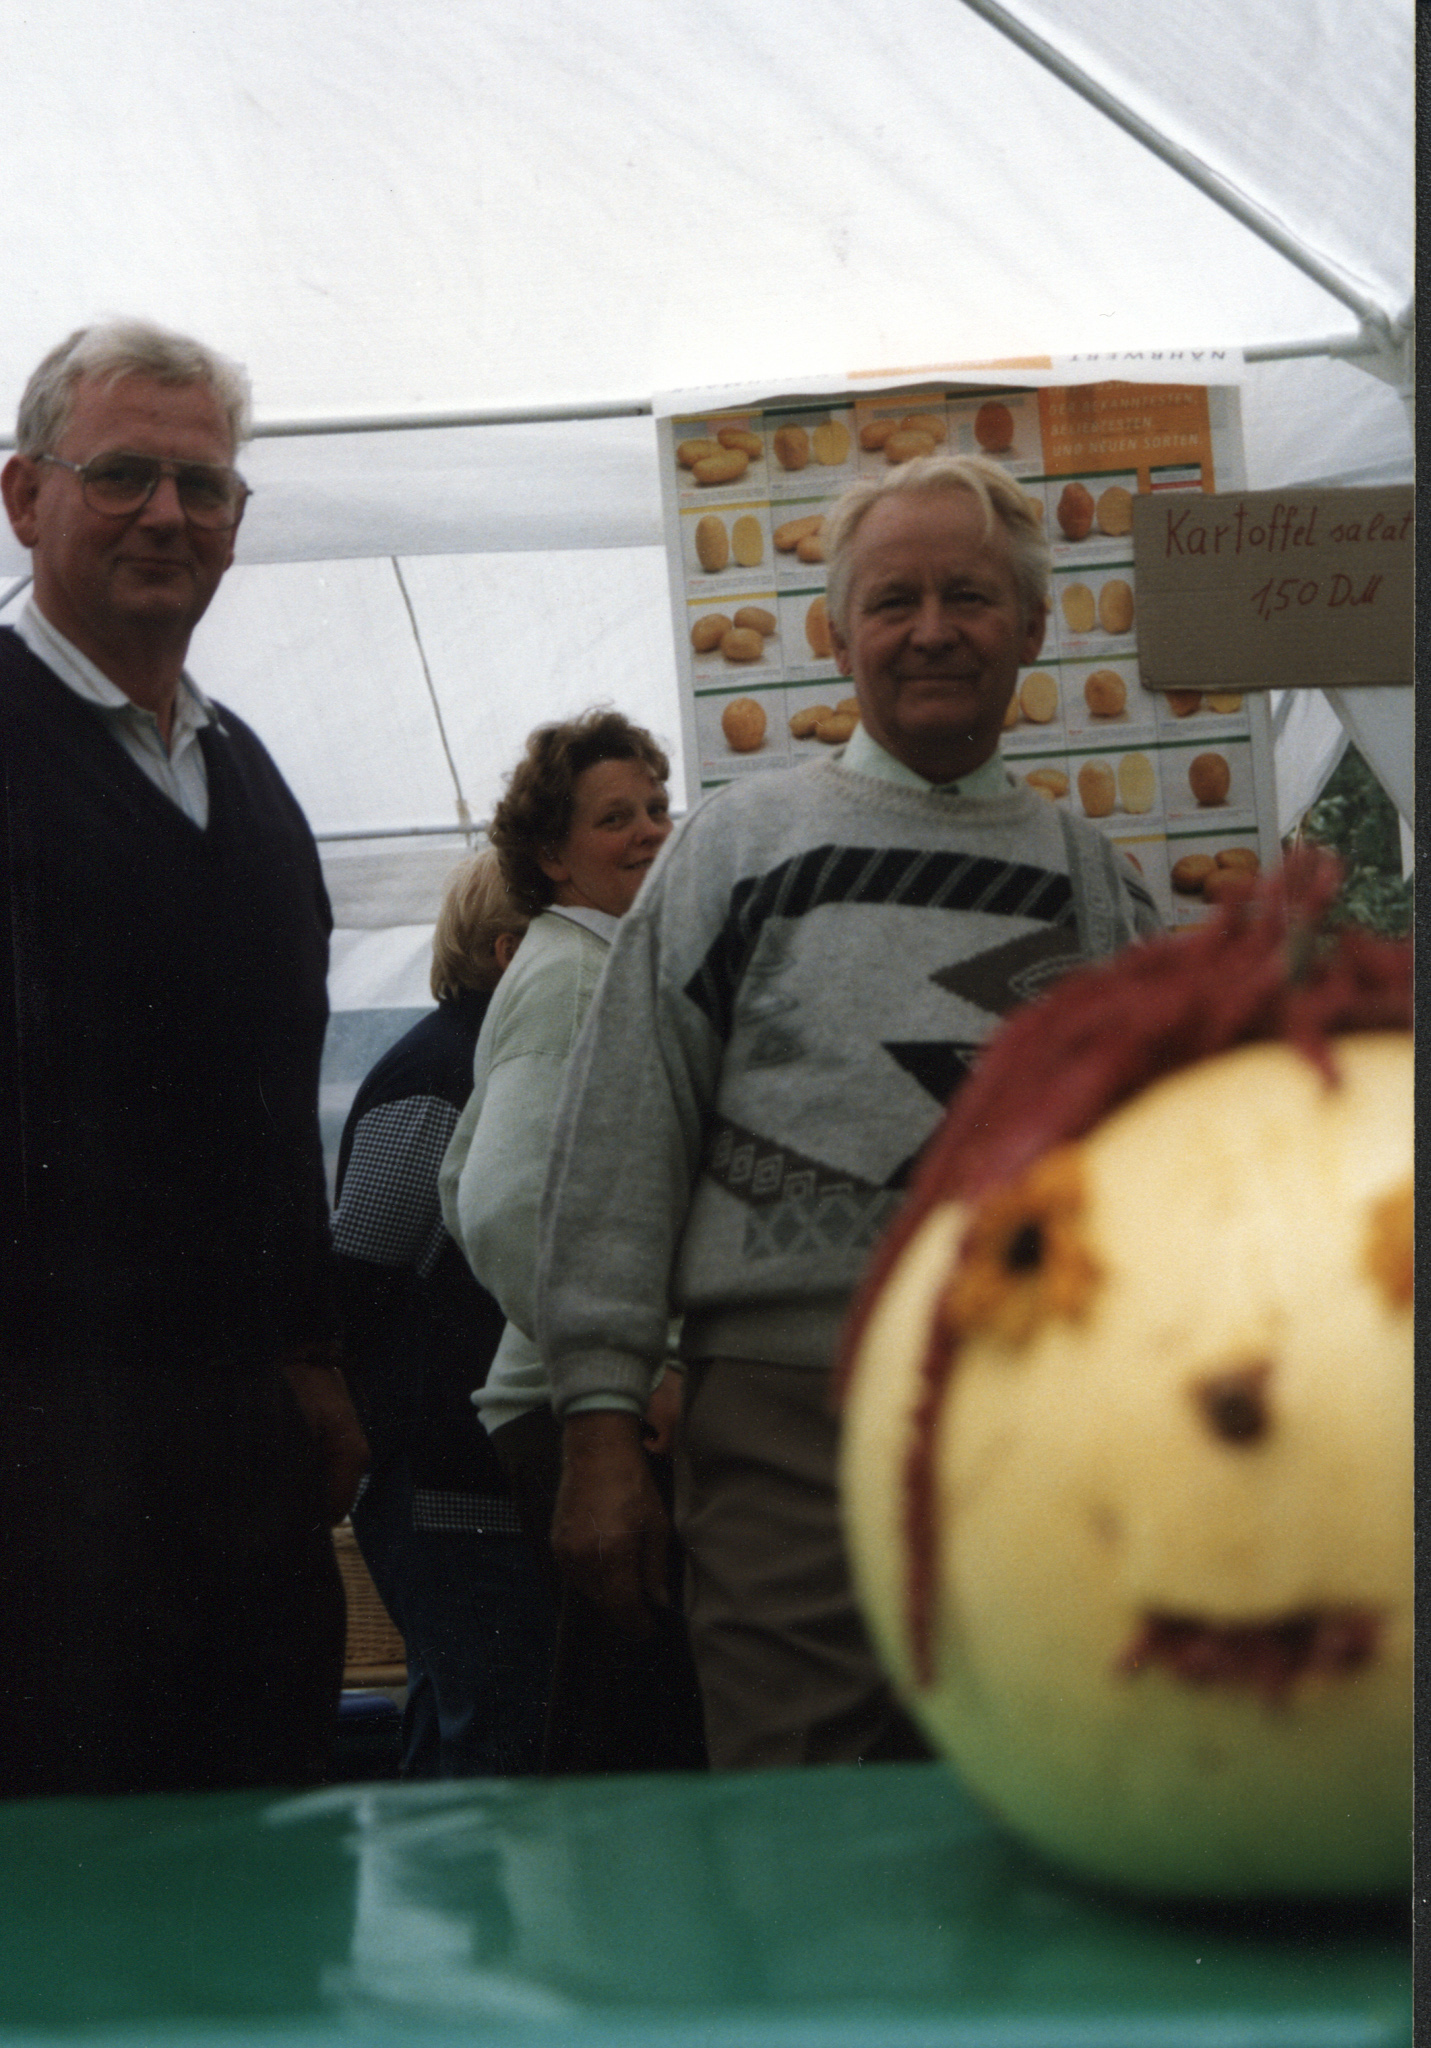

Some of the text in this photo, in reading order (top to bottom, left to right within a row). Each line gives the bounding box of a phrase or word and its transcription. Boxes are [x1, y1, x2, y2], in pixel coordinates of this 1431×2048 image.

[1052, 441, 1083, 457] UND
[1087, 437, 1138, 454] NEUEN
[1165, 503, 1414, 557] Kartoffel salat
[1250, 577, 1319, 621] 1,50
